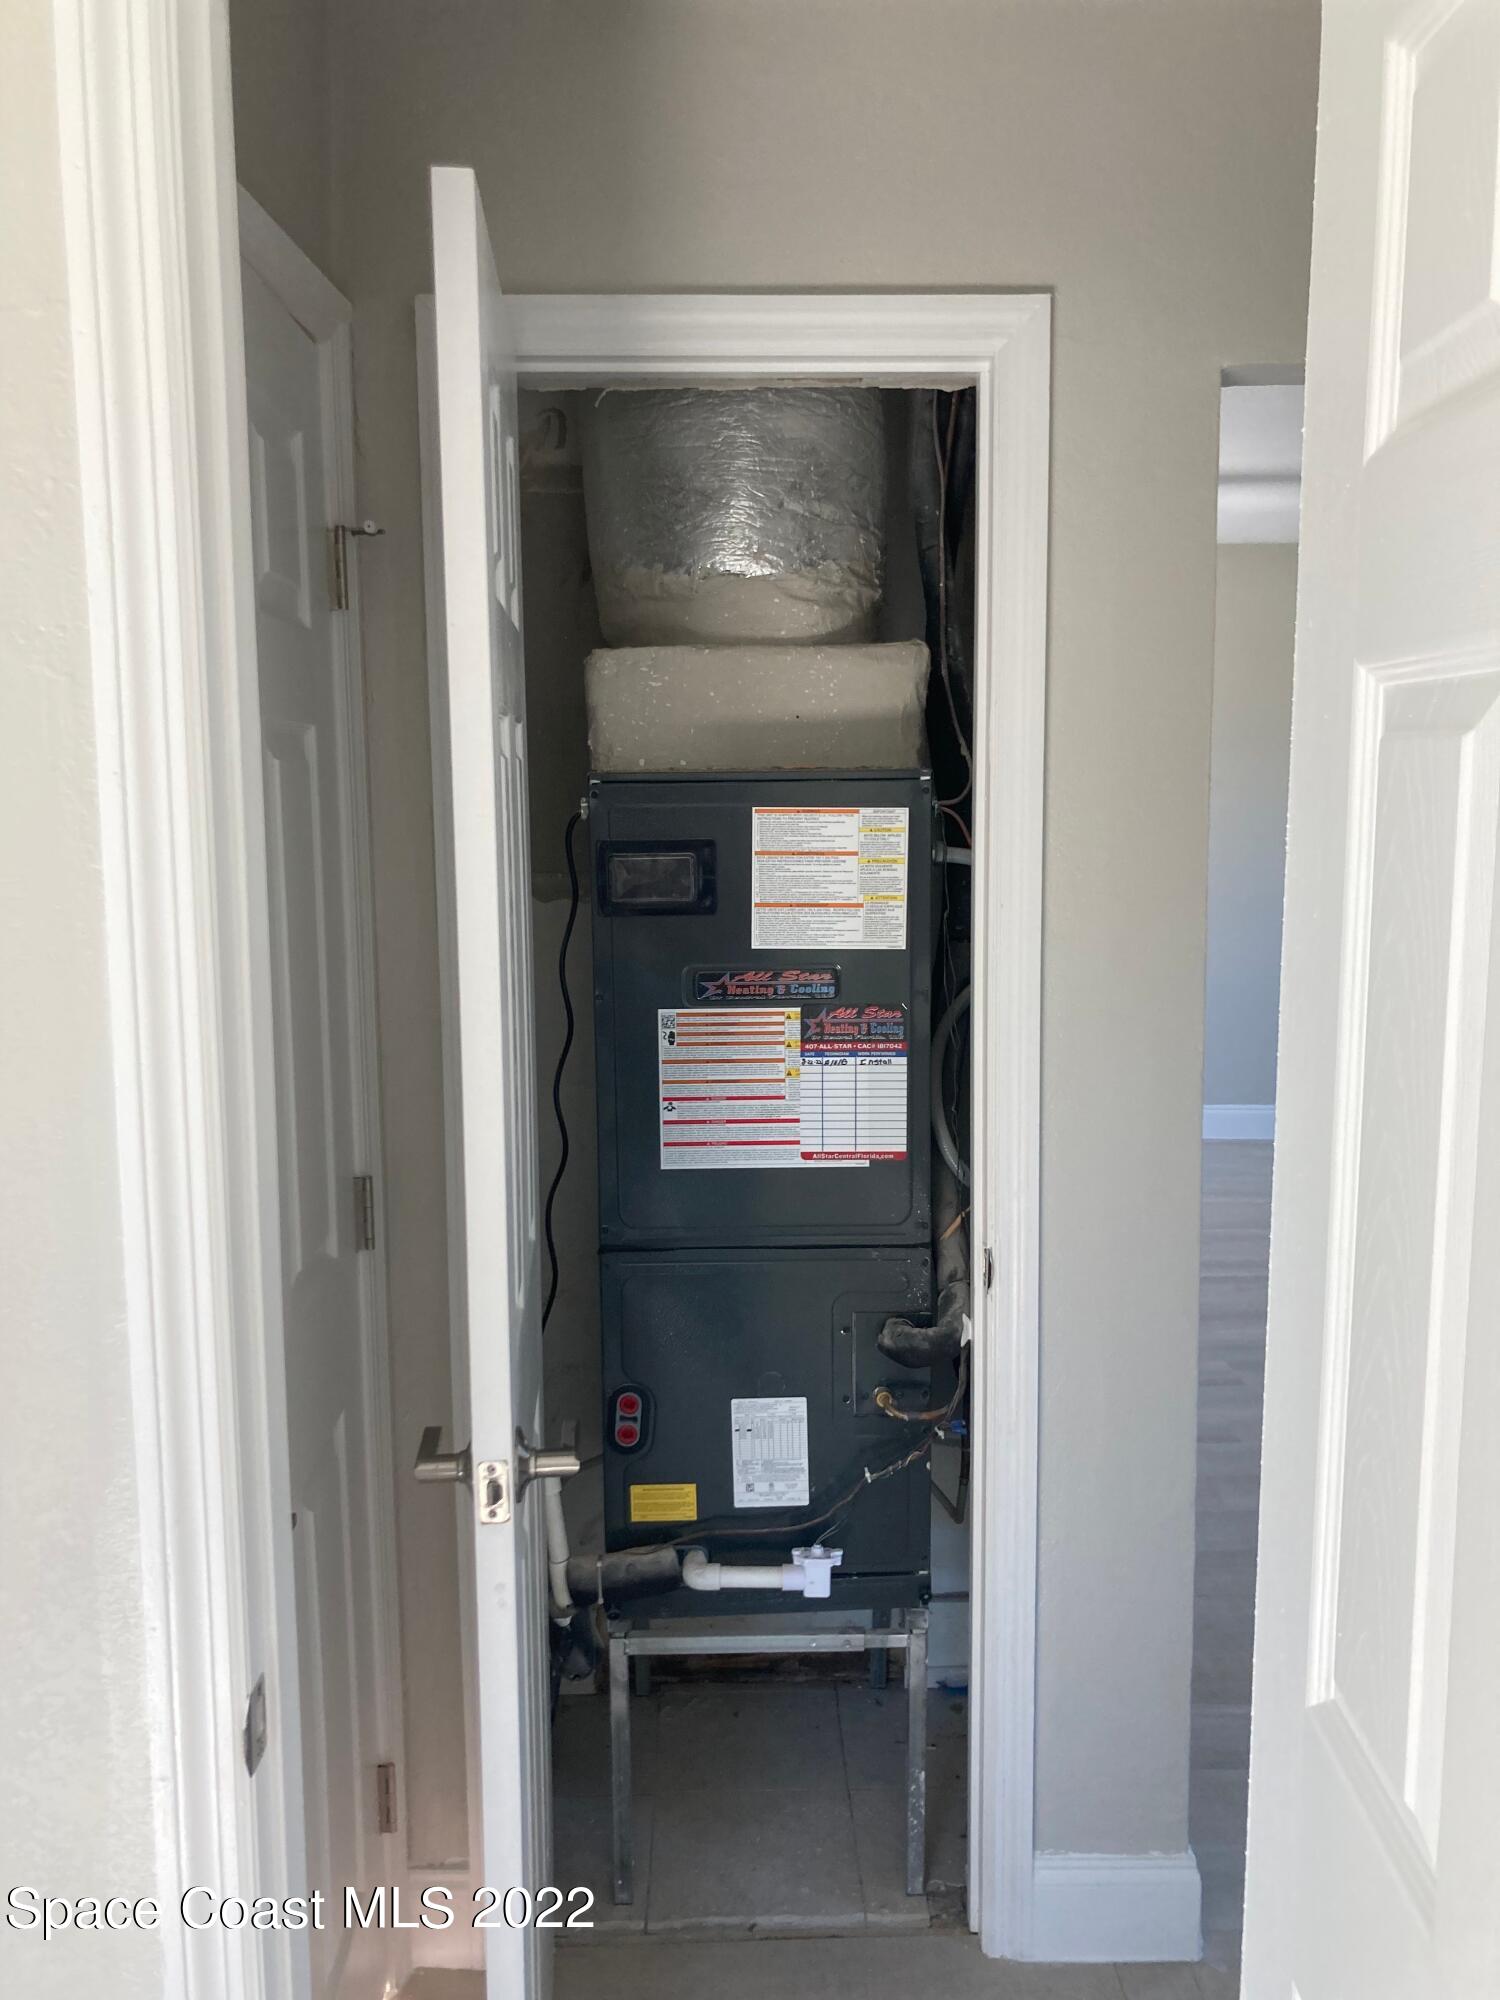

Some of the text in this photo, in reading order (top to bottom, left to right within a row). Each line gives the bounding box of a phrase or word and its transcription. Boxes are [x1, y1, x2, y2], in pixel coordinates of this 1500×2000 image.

[734, 968, 833, 982] All Star
[727, 983, 836, 996] Heating & Cooling
[829, 1006, 903, 1019] All Star
[824, 1022, 905, 1035] Heating & Cooling
